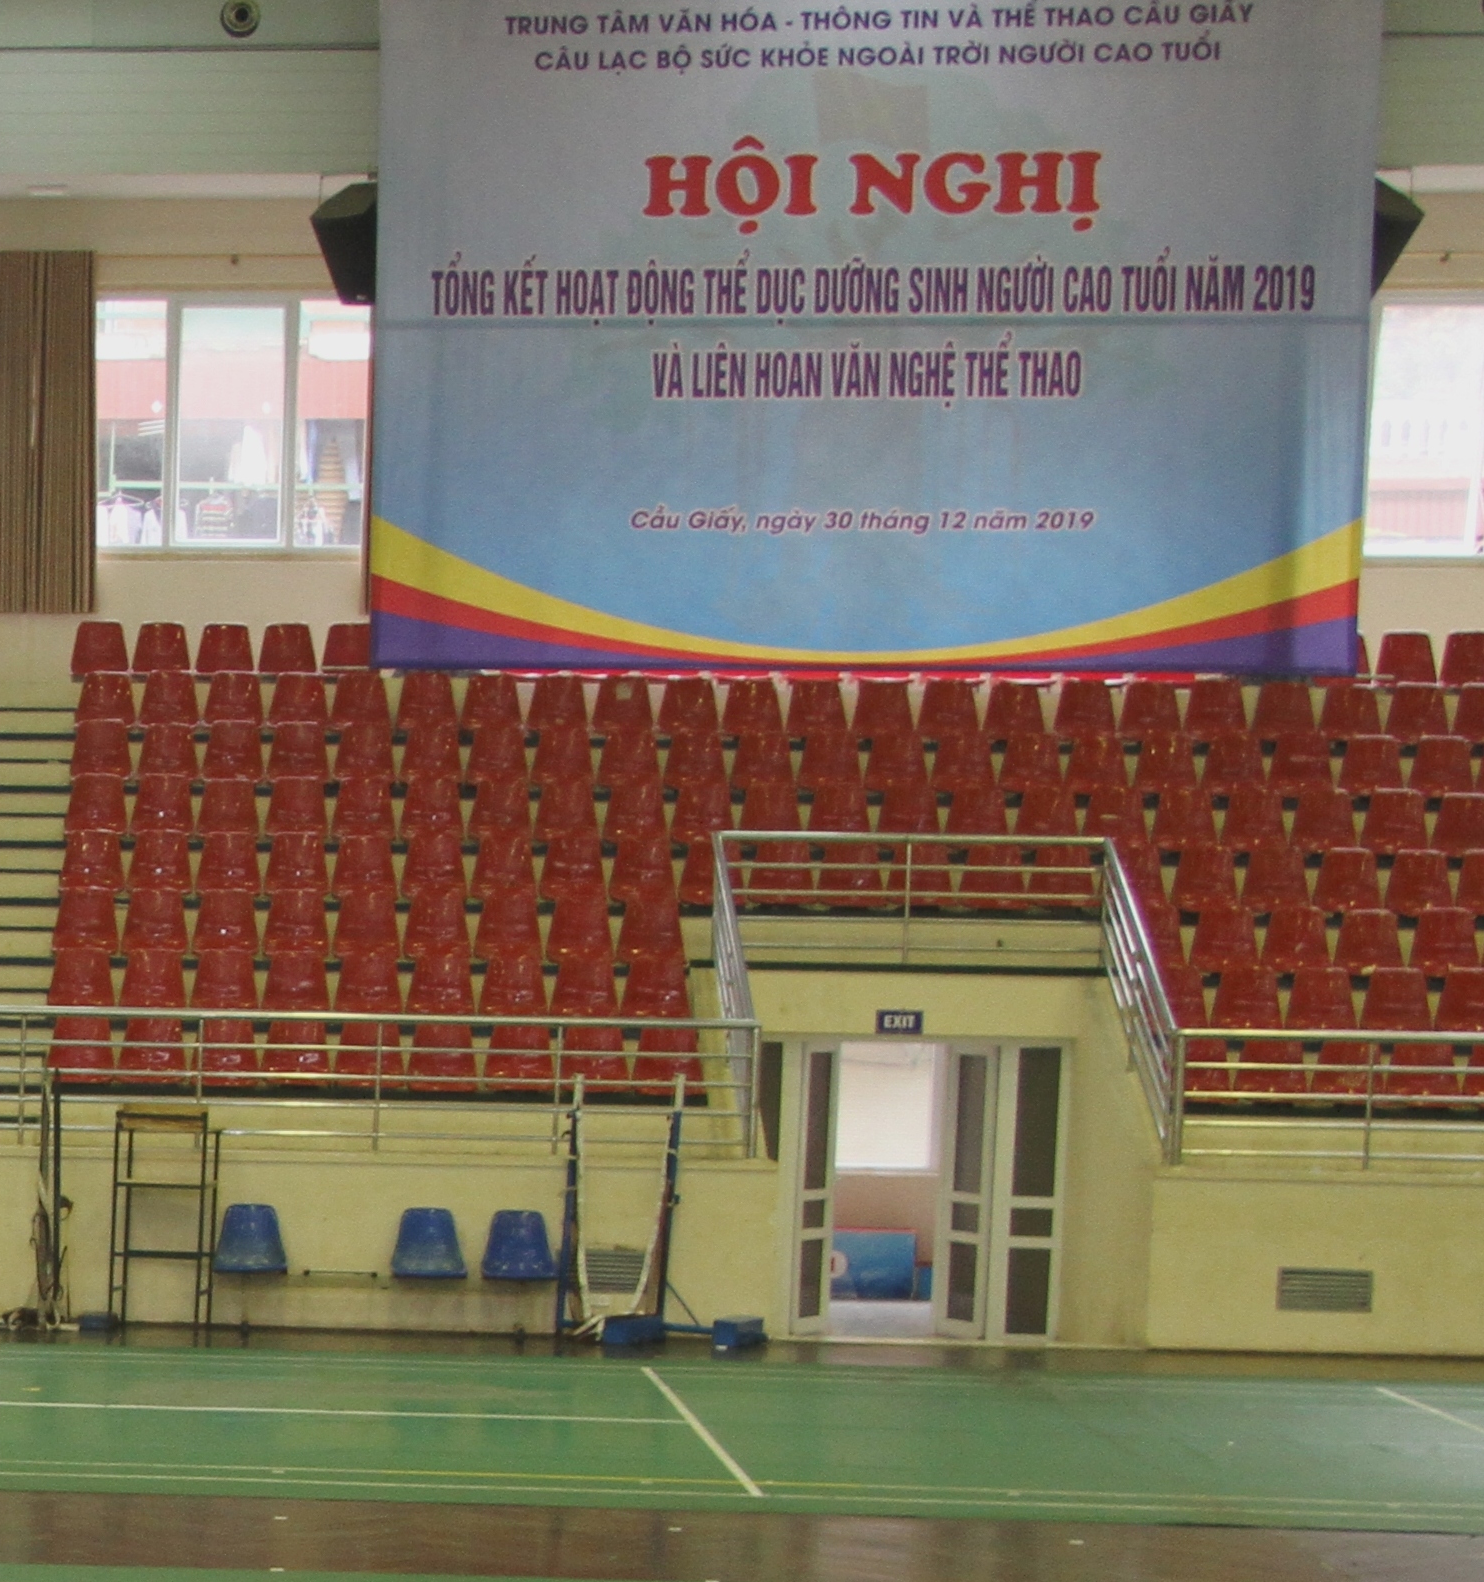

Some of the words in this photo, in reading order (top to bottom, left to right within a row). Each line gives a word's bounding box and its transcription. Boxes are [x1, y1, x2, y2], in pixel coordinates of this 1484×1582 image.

[505, 14, 589, 36] TRUNG
[597, 9, 649, 34] TÂM
[659, 8, 711, 34] VĂN
[721, 5, 778, 32] HÓA
[800, 4, 891, 32] THÔNG
[900, 10, 939, 30] TIN
[947, 5, 983, 29] VÀ
[1044, 6, 1115, 28] THAO
[535, 46, 589, 70] CÂU
[598, 50, 648, 77] LẠC
[656, 46, 692, 76] BỘ
[700, 43, 751, 69] SỨC
[760, 41, 829, 68] KHỎE
[839, 42, 924, 66] NGOÀI
[933, 39, 989, 65] TRỜI
[998, 38, 1084, 64] NGƯỜI
[1094, 42, 1154, 63] CAO
[1162, 30, 1220, 62] TUỔI
[642, 134, 819, 235] HỘI
[848, 150, 1102, 232] NGHỊ
[431, 250, 496, 317] TỔNG
[503, 254, 548, 316] KẾT
[556, 268, 620, 327] HOẠT
[627, 259, 695, 327] ĐỘNG
[703, 249, 750, 315] THỂ
[756, 268, 806, 327] DỤC
[813, 256, 900, 315] DƯỠNG
[908, 266, 969, 314] SINH
[976, 253, 1055, 314] NGƯỜI
[1062, 266, 1113, 313] CAO
[1121, 246, 1177, 313] TUỔI
[1185, 253, 1246, 312] NĂM
[1252, 264, 1316, 312] 2019
[651, 341, 684, 398] VÀ
[691, 341, 747, 398] LIÊN
[754, 350, 823, 398] HOAN
[831, 340, 881, 398] VĂN
[888, 340, 956, 409] NGHỆ
[964, 329, 1014, 397] THỂ
[1018, 350, 1082, 397] THAO
[630, 504, 679, 530] Cầu
[687, 506, 747, 535] Giấy,
[755, 508, 816, 534] ngày
[823, 510, 853, 530] 30
[859, 508, 930, 534] tháng
[938, 510, 967, 530] 12
[973, 509, 1028, 531] năm
[1034, 509, 1095, 530] 2019
[882, 1014, 916, 1030] EXIT
